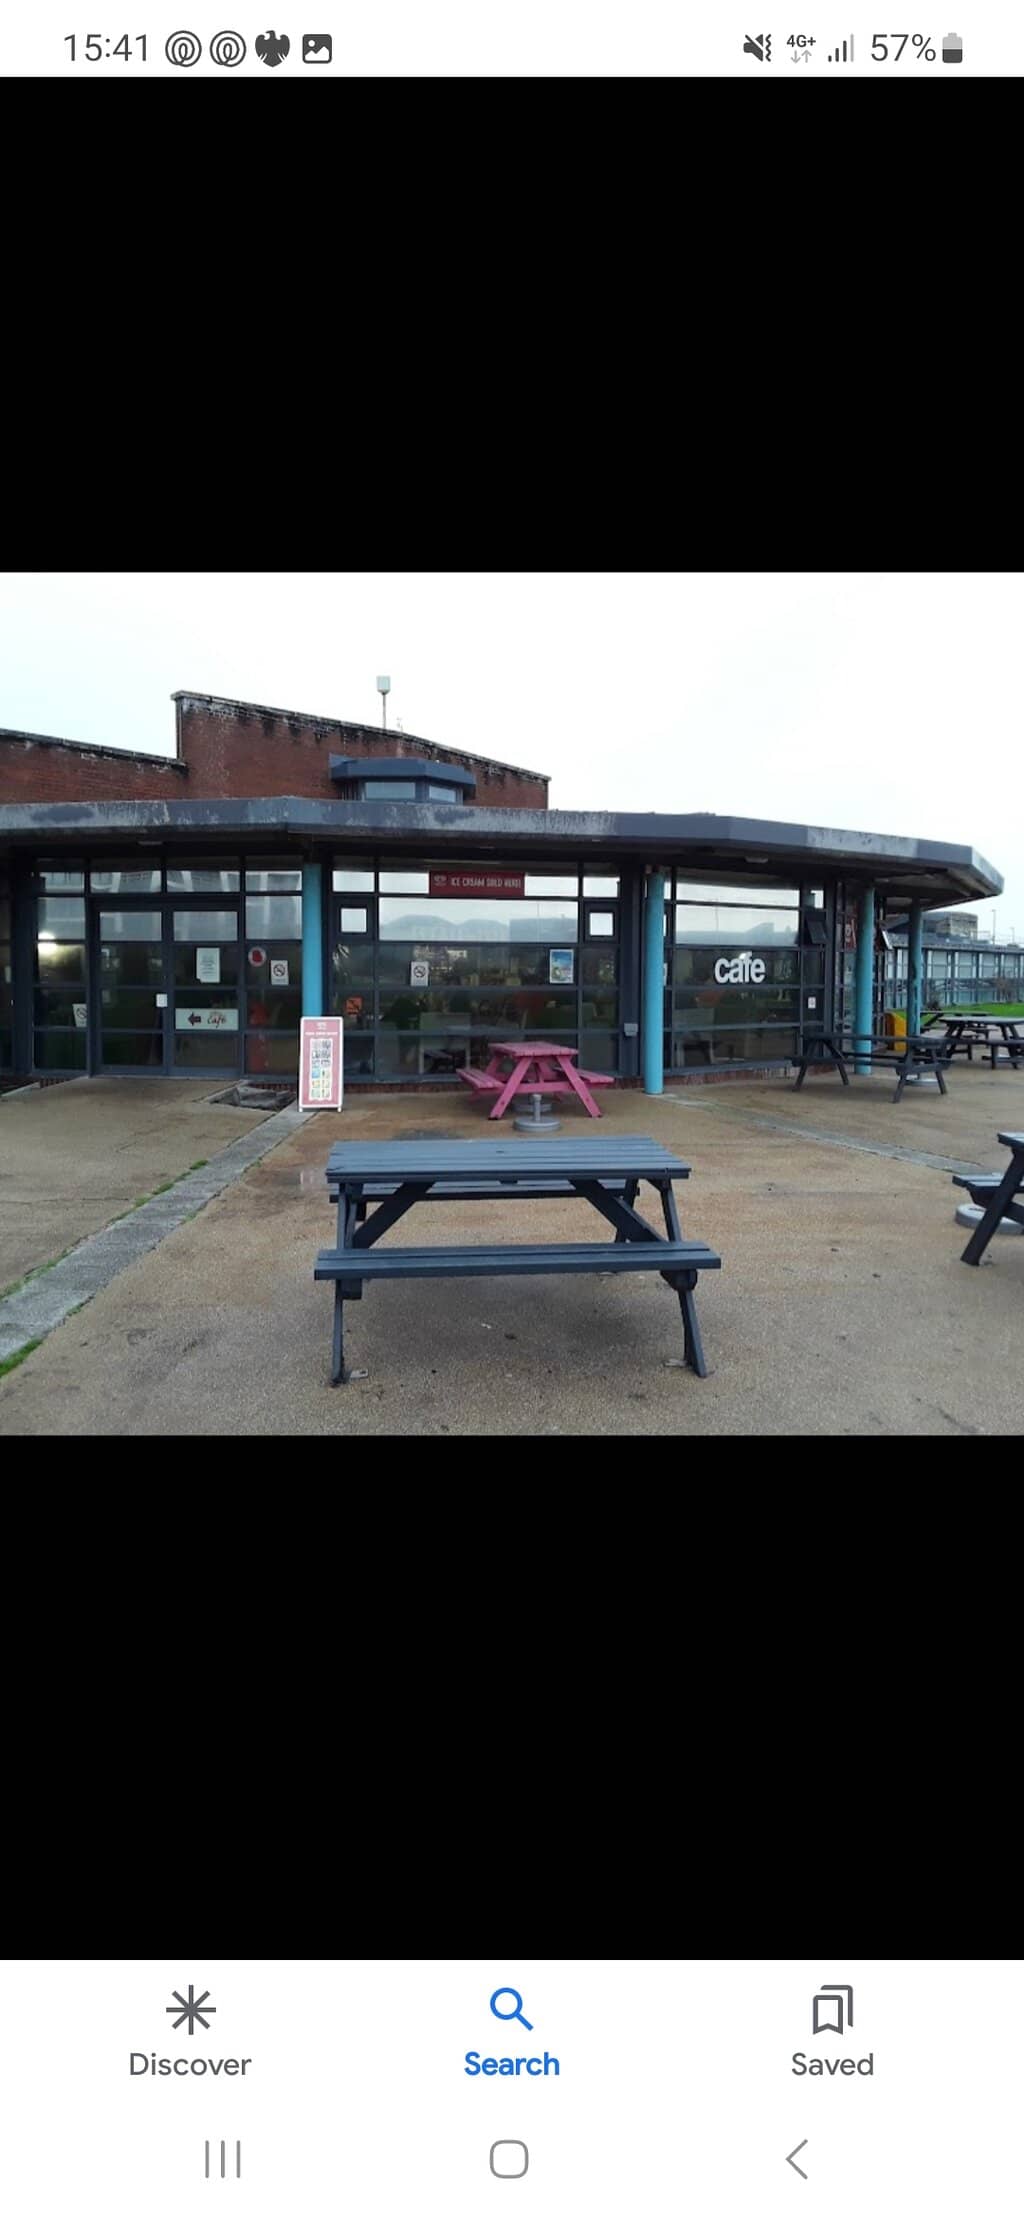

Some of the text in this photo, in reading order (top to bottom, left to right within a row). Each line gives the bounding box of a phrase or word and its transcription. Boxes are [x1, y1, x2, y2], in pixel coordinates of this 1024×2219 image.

[451, 876, 460, 887] ICE
[462, 877, 485, 887] CREAM
[486, 877, 503, 888] SOLD
